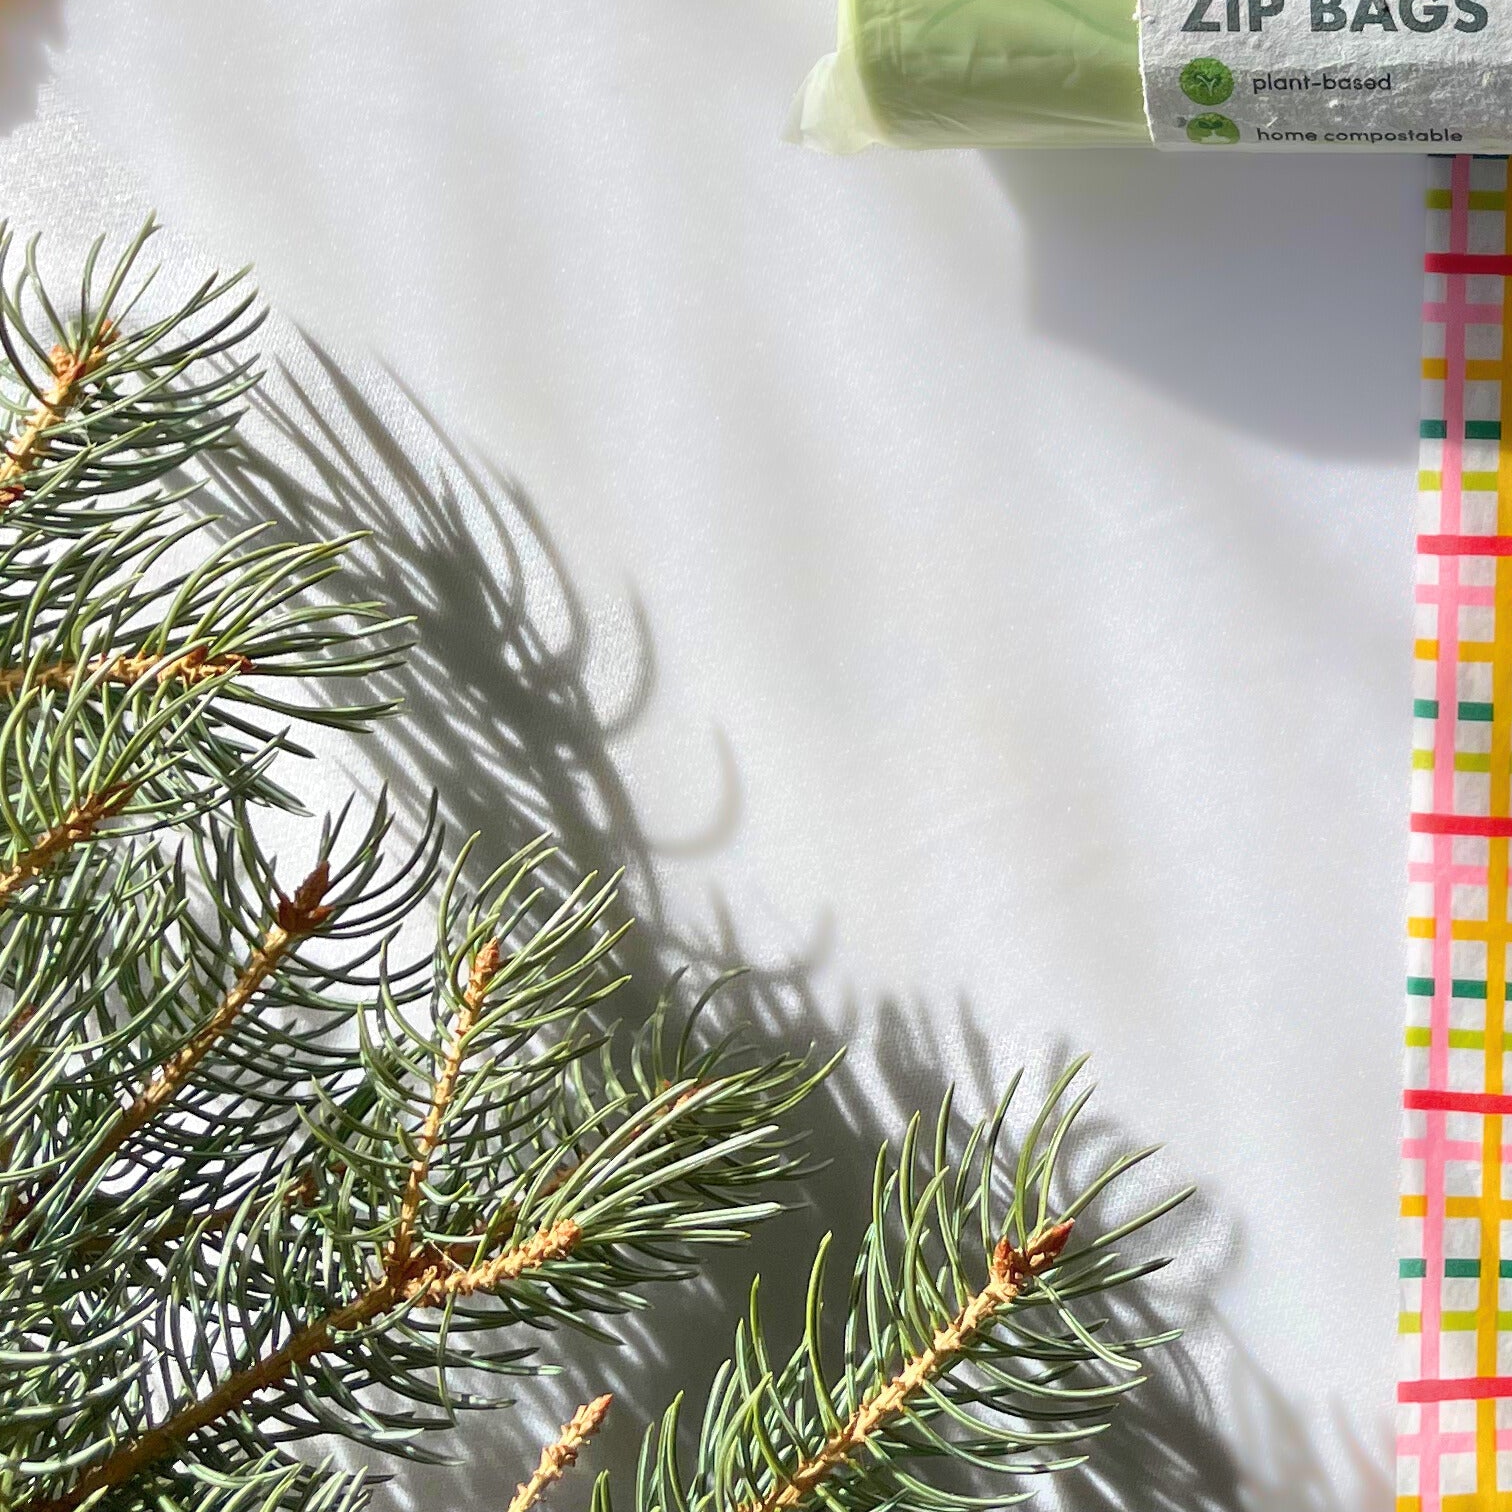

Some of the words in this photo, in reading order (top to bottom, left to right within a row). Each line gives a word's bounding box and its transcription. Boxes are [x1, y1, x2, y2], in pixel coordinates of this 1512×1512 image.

[1252, 72, 1392, 95] plant-based
[1256, 127, 1318, 143] home
[1324, 127, 1464, 144] compostable
